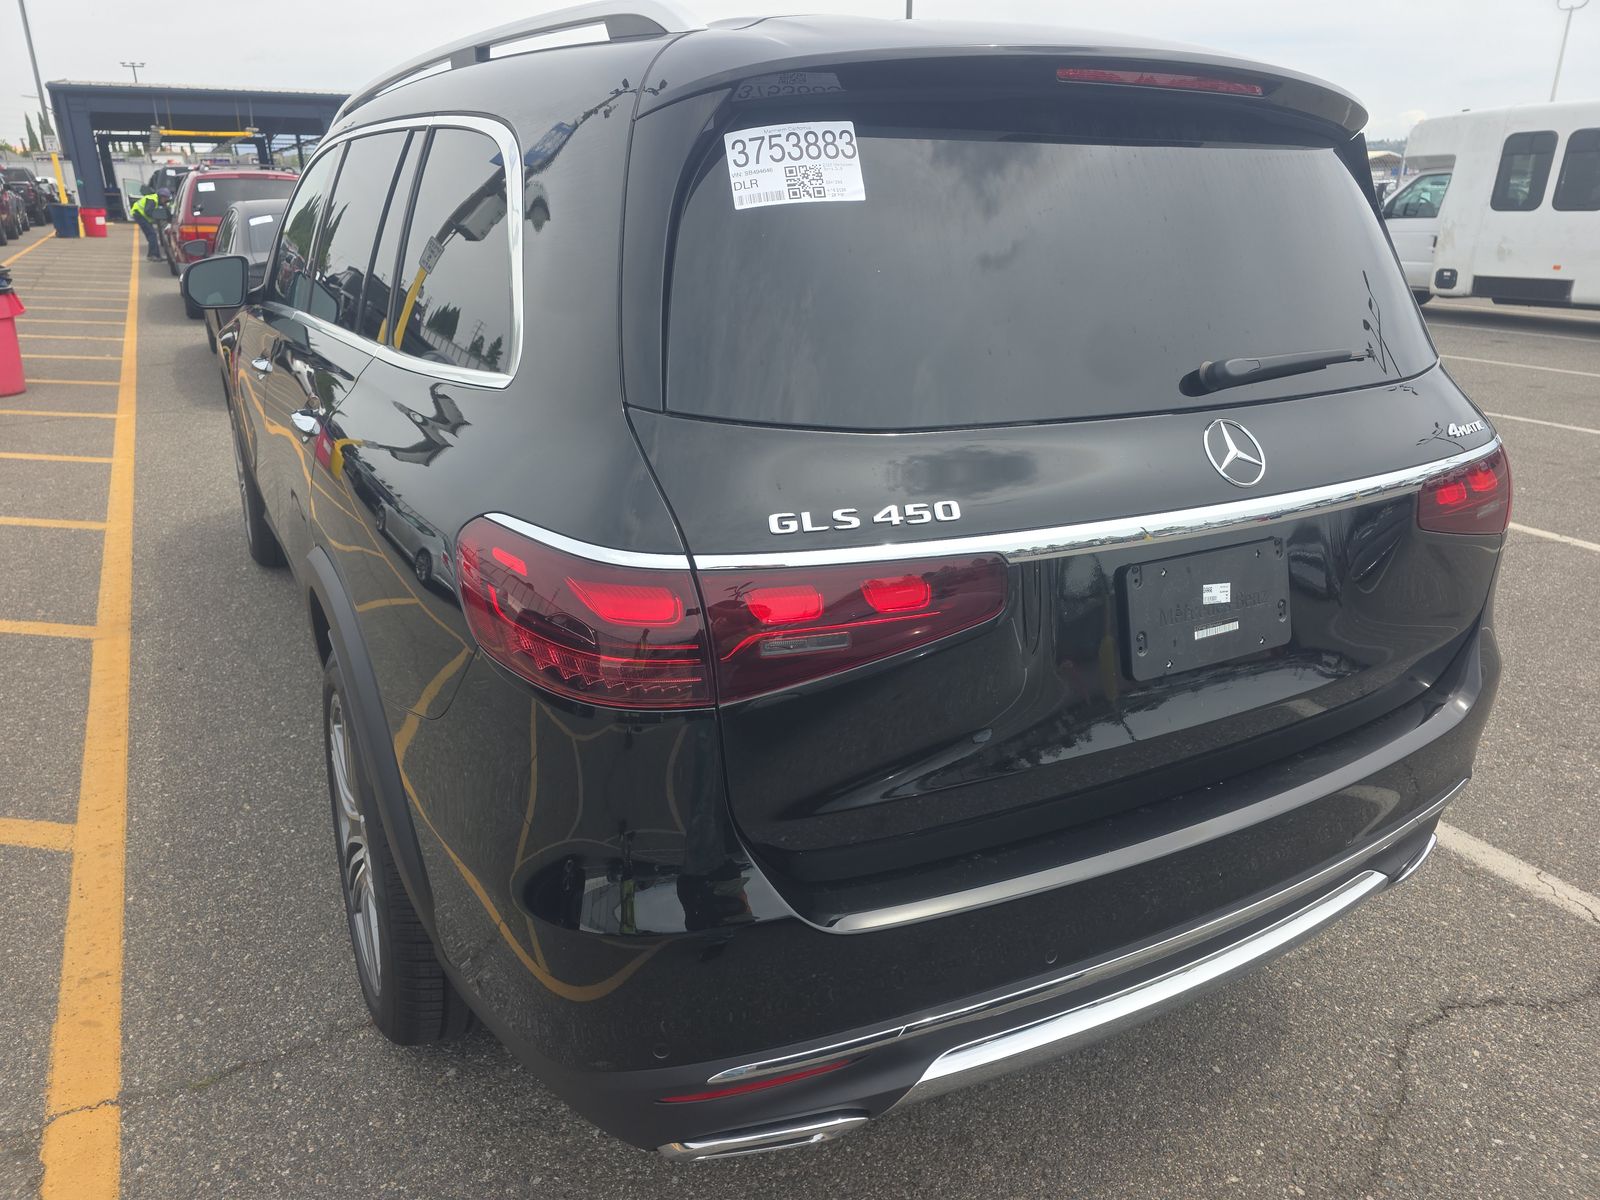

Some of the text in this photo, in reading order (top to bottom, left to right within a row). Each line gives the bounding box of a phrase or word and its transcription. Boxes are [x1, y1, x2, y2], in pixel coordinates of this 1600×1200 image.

[731, 130, 857, 168] 3753883
[733, 178, 759, 191] DLR
[1447, 419, 1485, 438] 4MATIC
[768, 500, 962, 535] GLS 450
